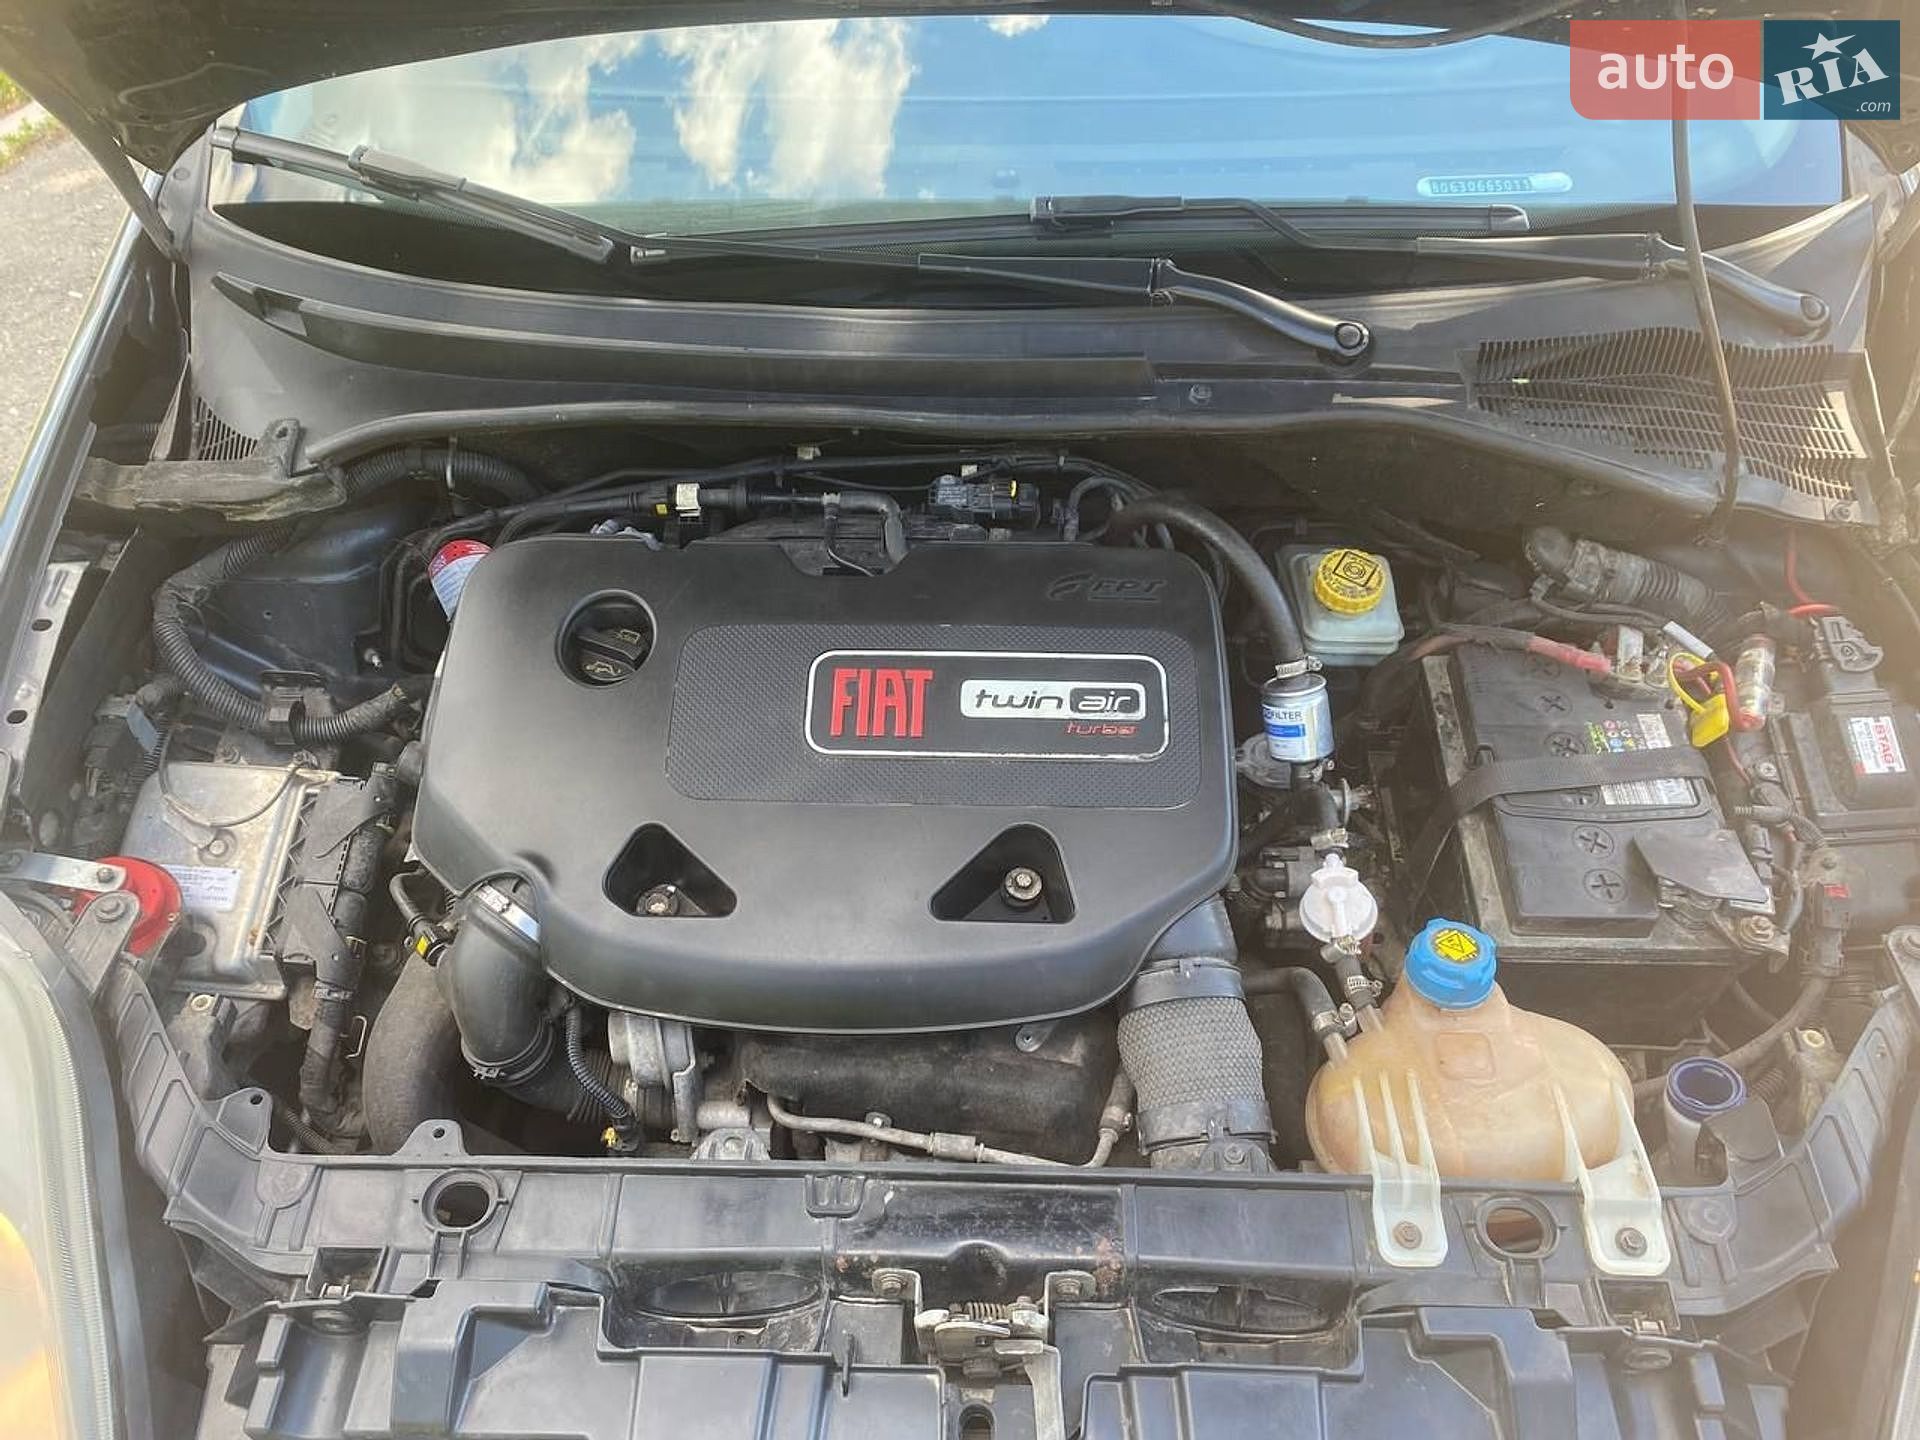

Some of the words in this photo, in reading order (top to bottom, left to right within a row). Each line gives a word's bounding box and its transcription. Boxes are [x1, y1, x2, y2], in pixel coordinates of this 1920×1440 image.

[830, 668, 934, 738] FIAT
[975, 688, 1064, 711] twin
[1077, 692, 1132, 712] air
[1064, 720, 1140, 737] turbo
